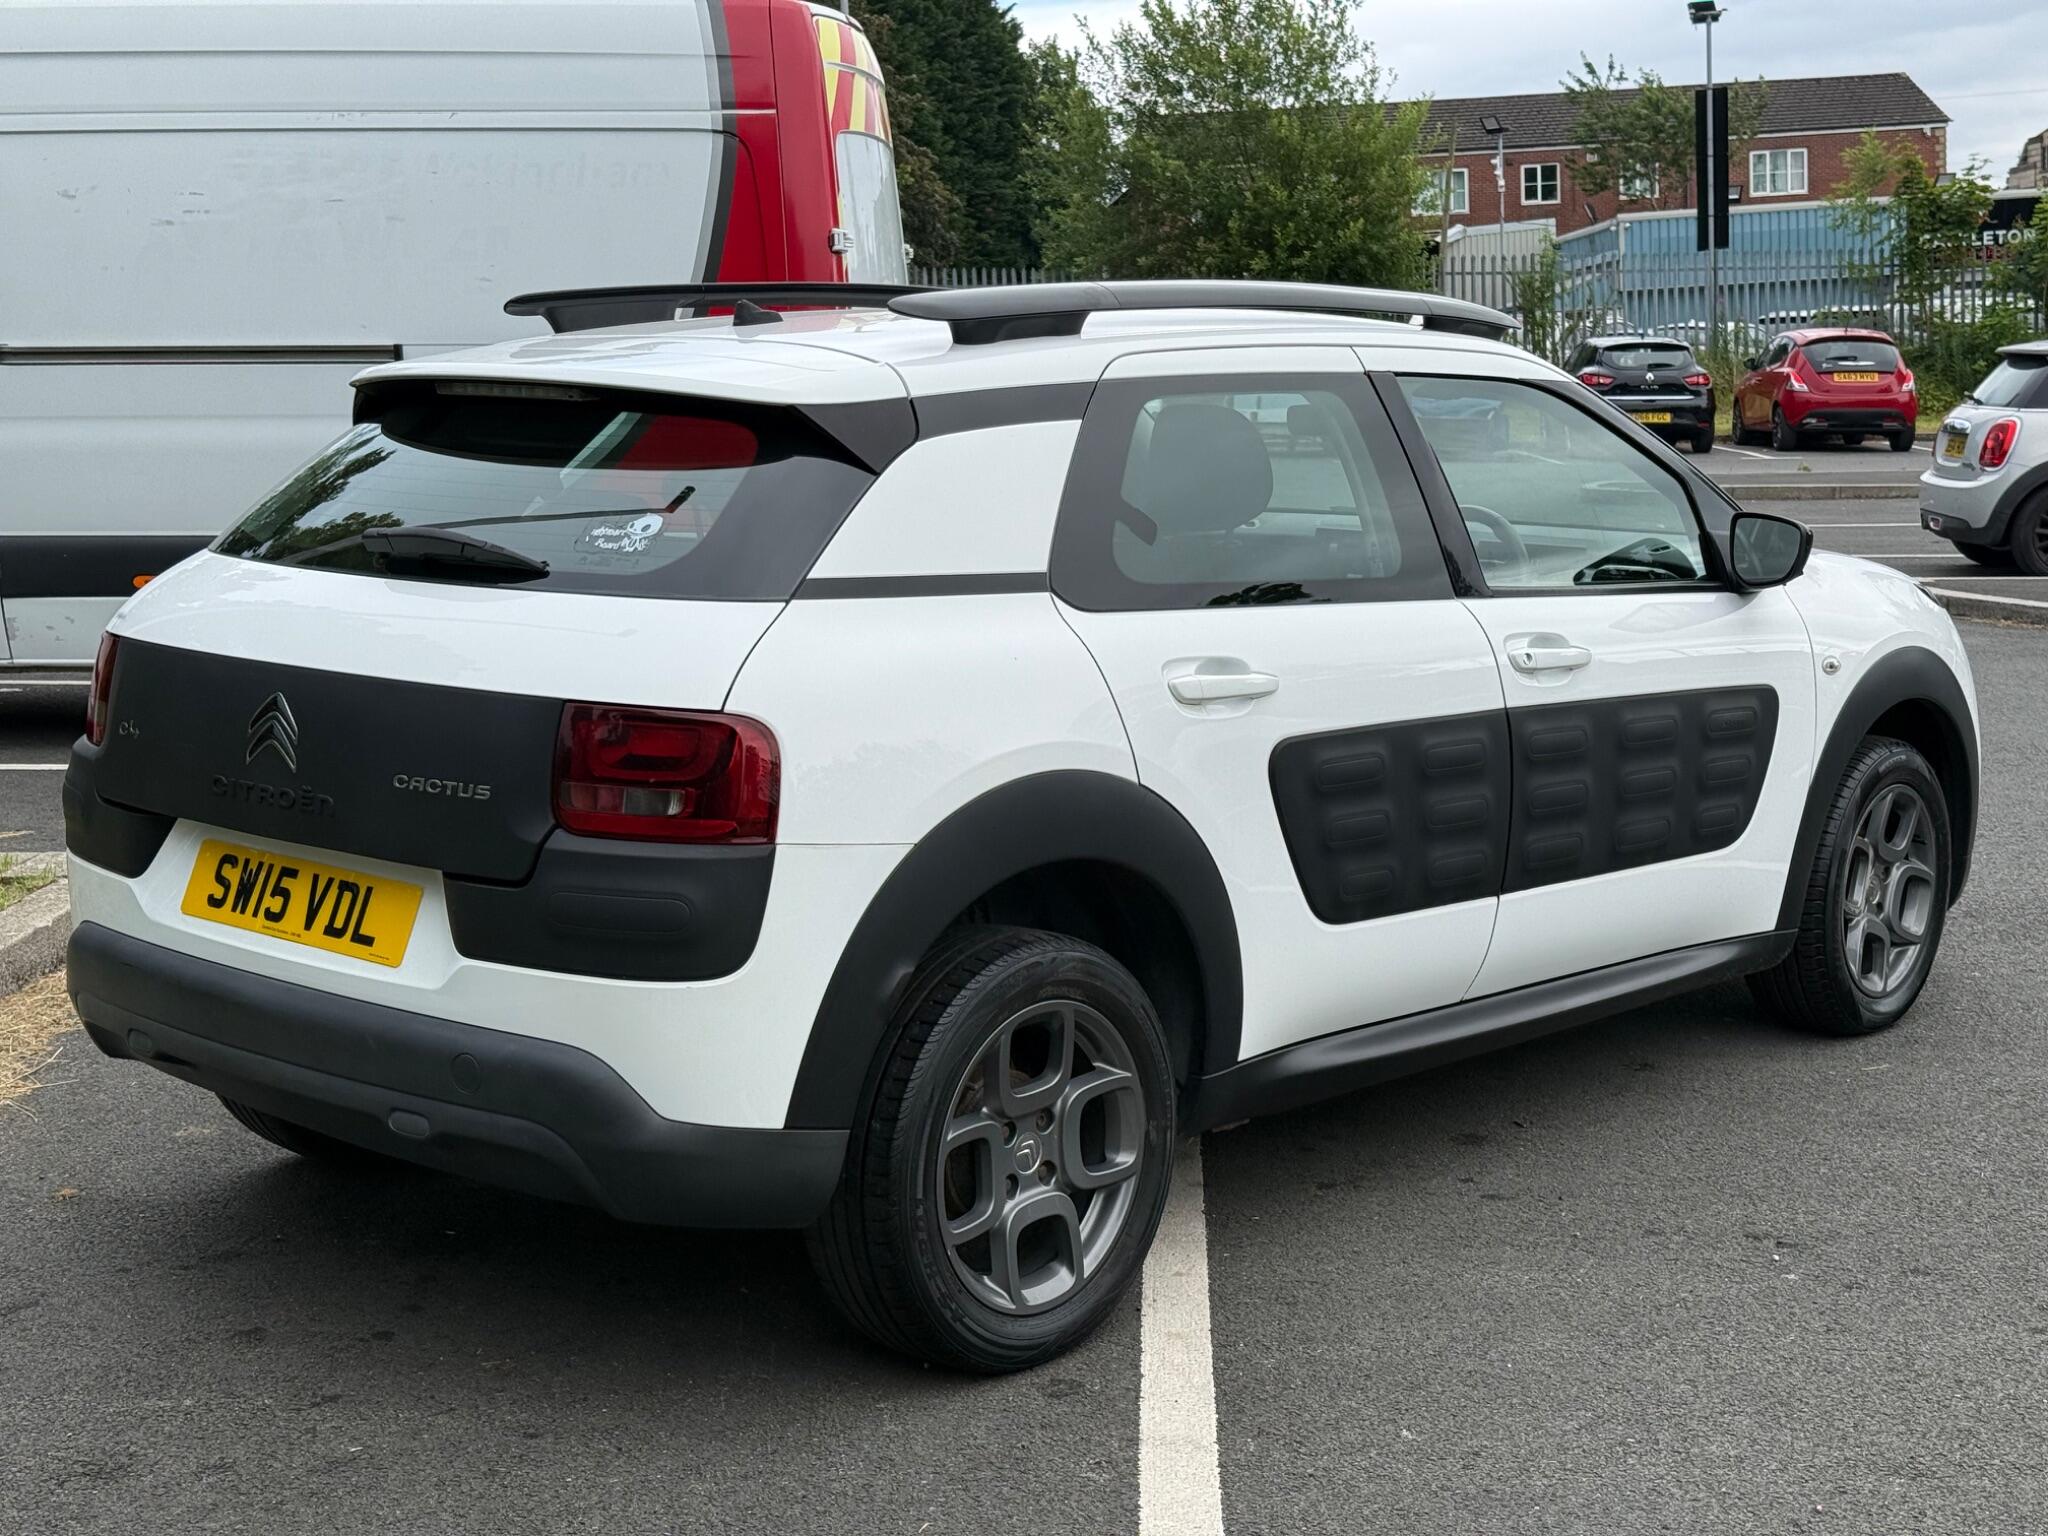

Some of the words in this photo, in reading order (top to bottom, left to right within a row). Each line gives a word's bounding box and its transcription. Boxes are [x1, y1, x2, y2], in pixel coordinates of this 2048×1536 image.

[118, 719, 141, 740] C4
[391, 773, 492, 801] CACTUS
[207, 853, 300, 924] SW15
[303, 872, 376, 948] VDL
